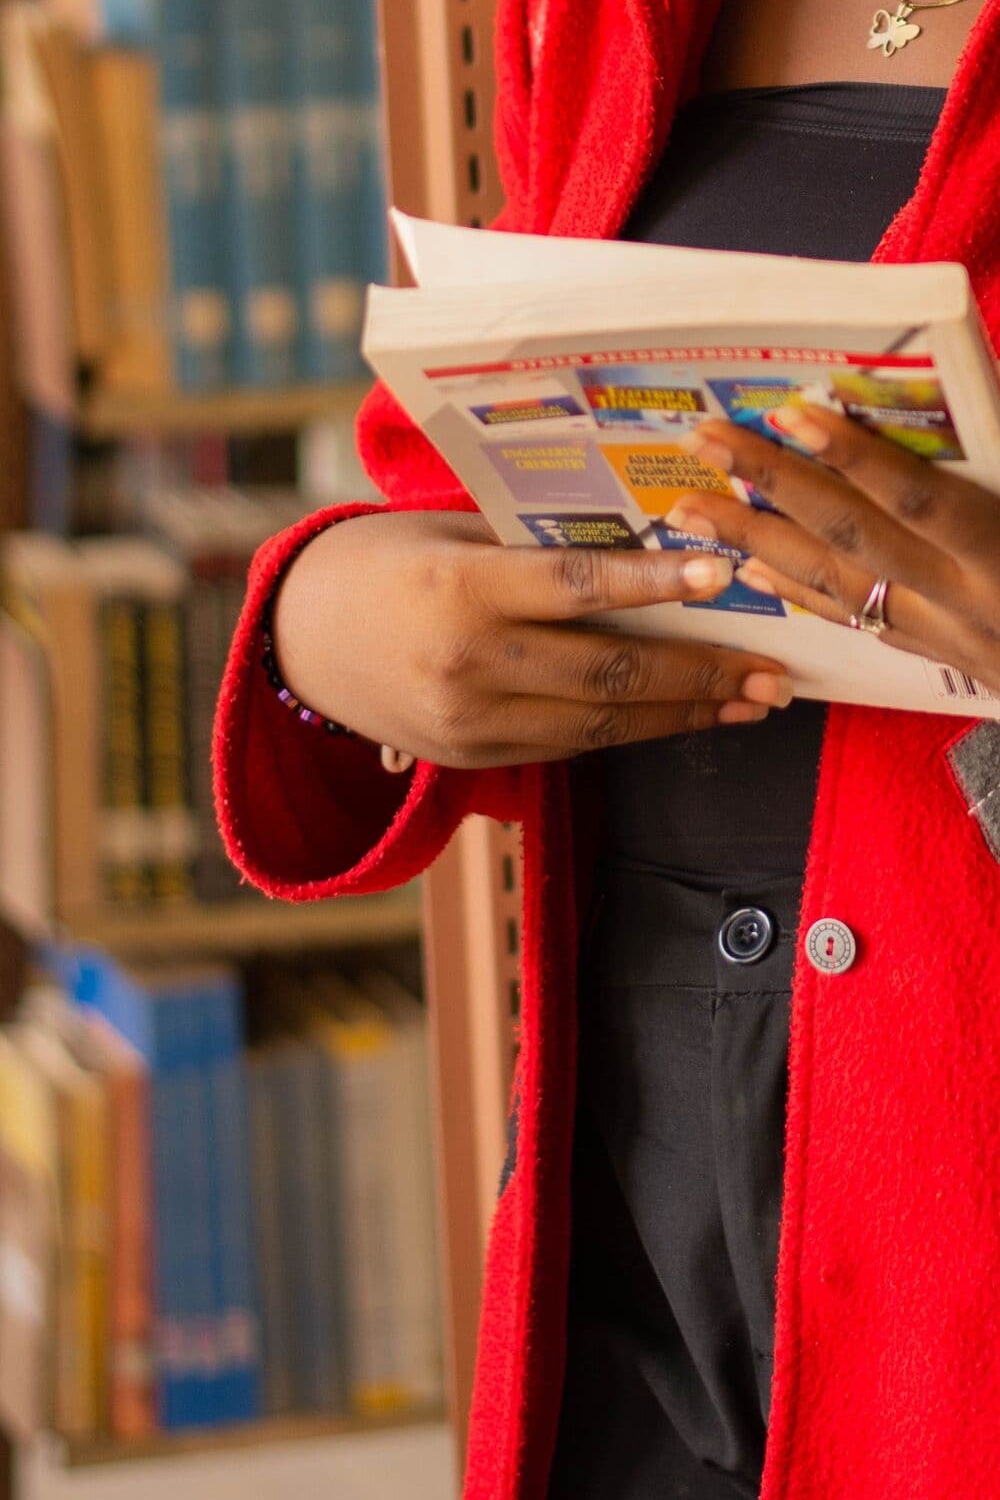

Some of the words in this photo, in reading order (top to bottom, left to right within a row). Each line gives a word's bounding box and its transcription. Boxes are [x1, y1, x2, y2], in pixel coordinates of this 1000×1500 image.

[769, 349, 848, 365] BOOKS
[628, 454, 701, 466] ADVANCED
[625, 465, 719, 478] ENGINEERING
[629, 477, 729, 491] MATHEMATICS
[559, 521, 620, 531] ENGINEERING
